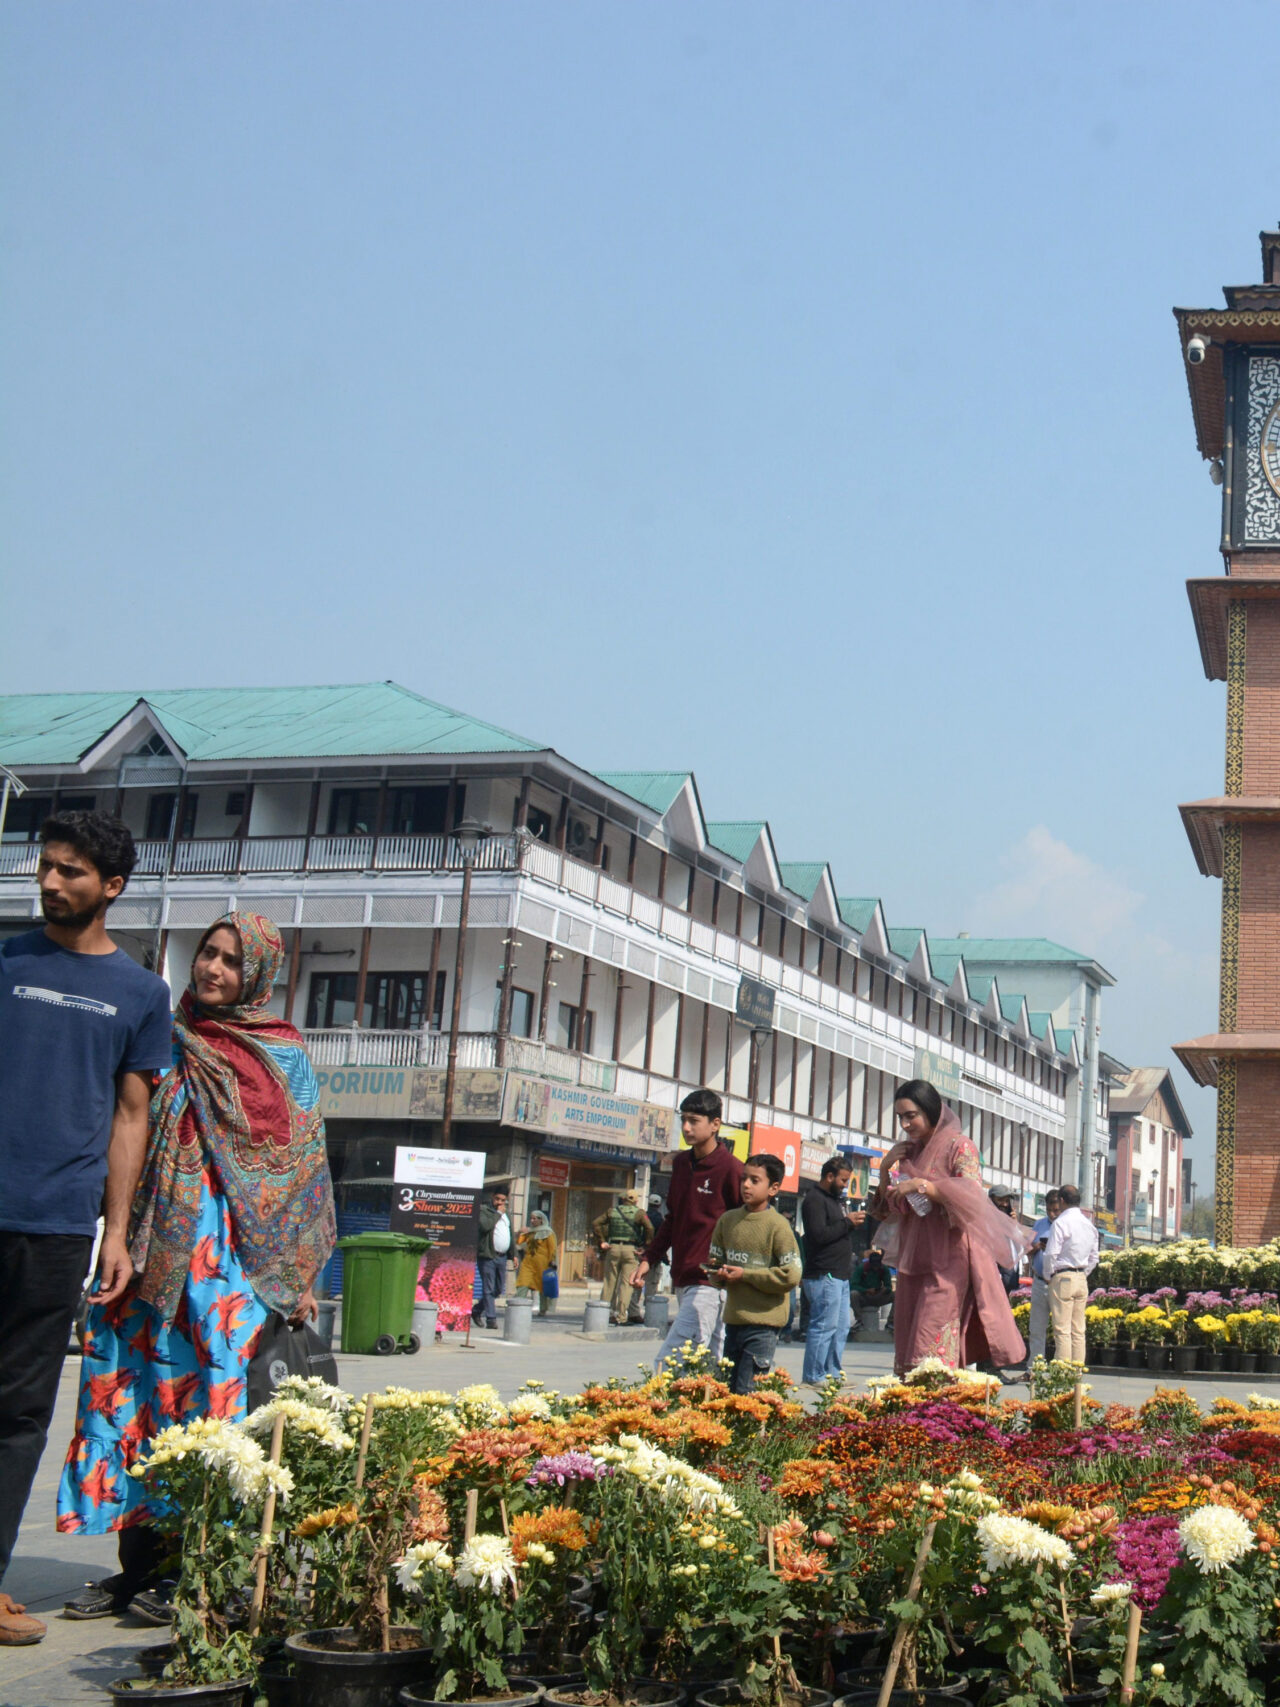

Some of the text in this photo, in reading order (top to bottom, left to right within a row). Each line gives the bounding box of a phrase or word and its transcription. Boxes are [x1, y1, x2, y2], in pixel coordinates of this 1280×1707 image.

[316, 1071, 405, 1095] PORIUM
[551, 1088, 640, 1117] KASHMIR GOVERNMENT
[564, 1107, 626, 1129] ARTS EMPORIUM
[398, 1188, 475, 1212] 3 Chrysanthemum
